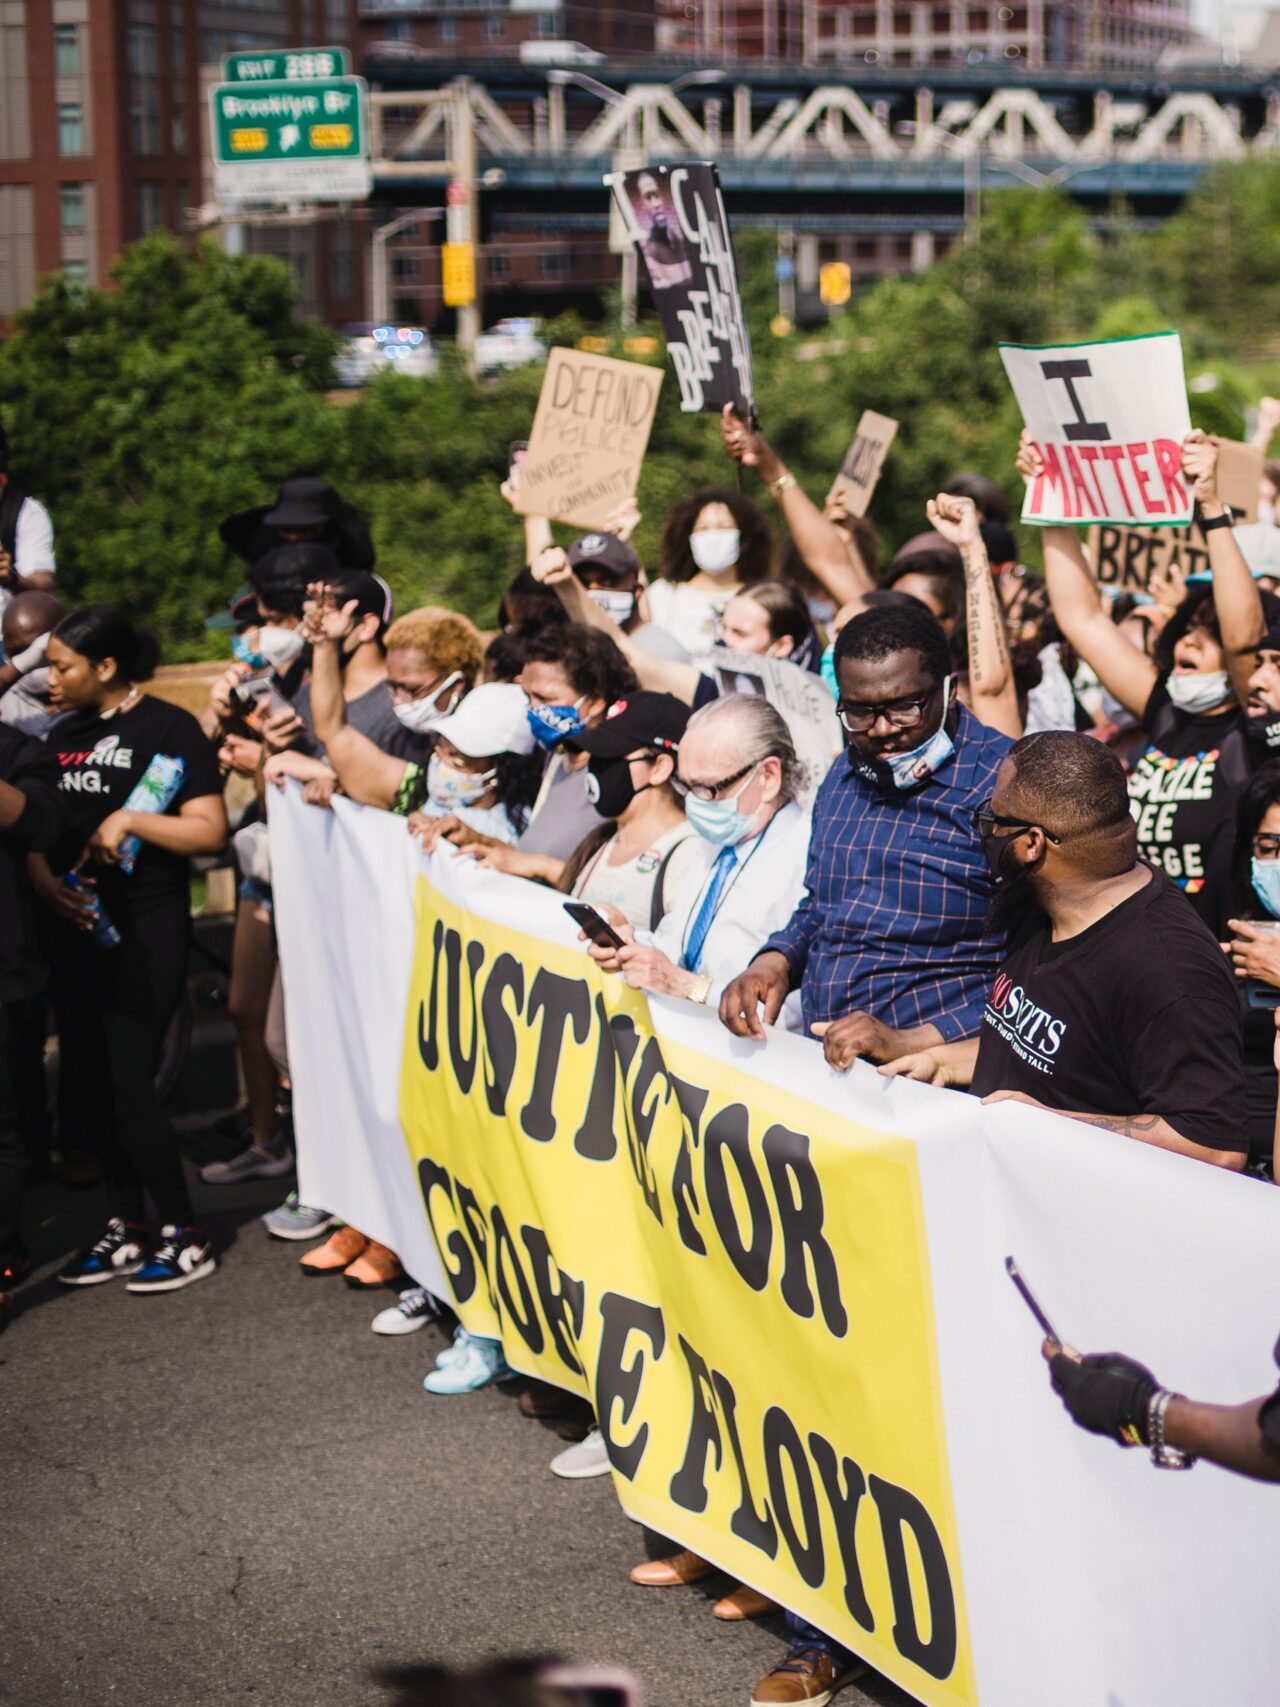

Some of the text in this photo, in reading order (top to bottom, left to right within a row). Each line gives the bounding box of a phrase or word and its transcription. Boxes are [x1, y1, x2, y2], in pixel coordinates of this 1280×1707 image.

[222, 90, 352, 122] Brooklyn Br
[602, 171, 648, 241] I
[552, 362, 653, 427] DEFUND
[1040, 358, 1111, 441] I
[541, 411, 642, 456] POLICE
[1029, 438, 1189, 517] MATTER
[1028, 1055, 1053, 1075] TALL.
[669, 1071, 848, 1338] FOR
[670, 1334, 956, 1680] FLOYD
